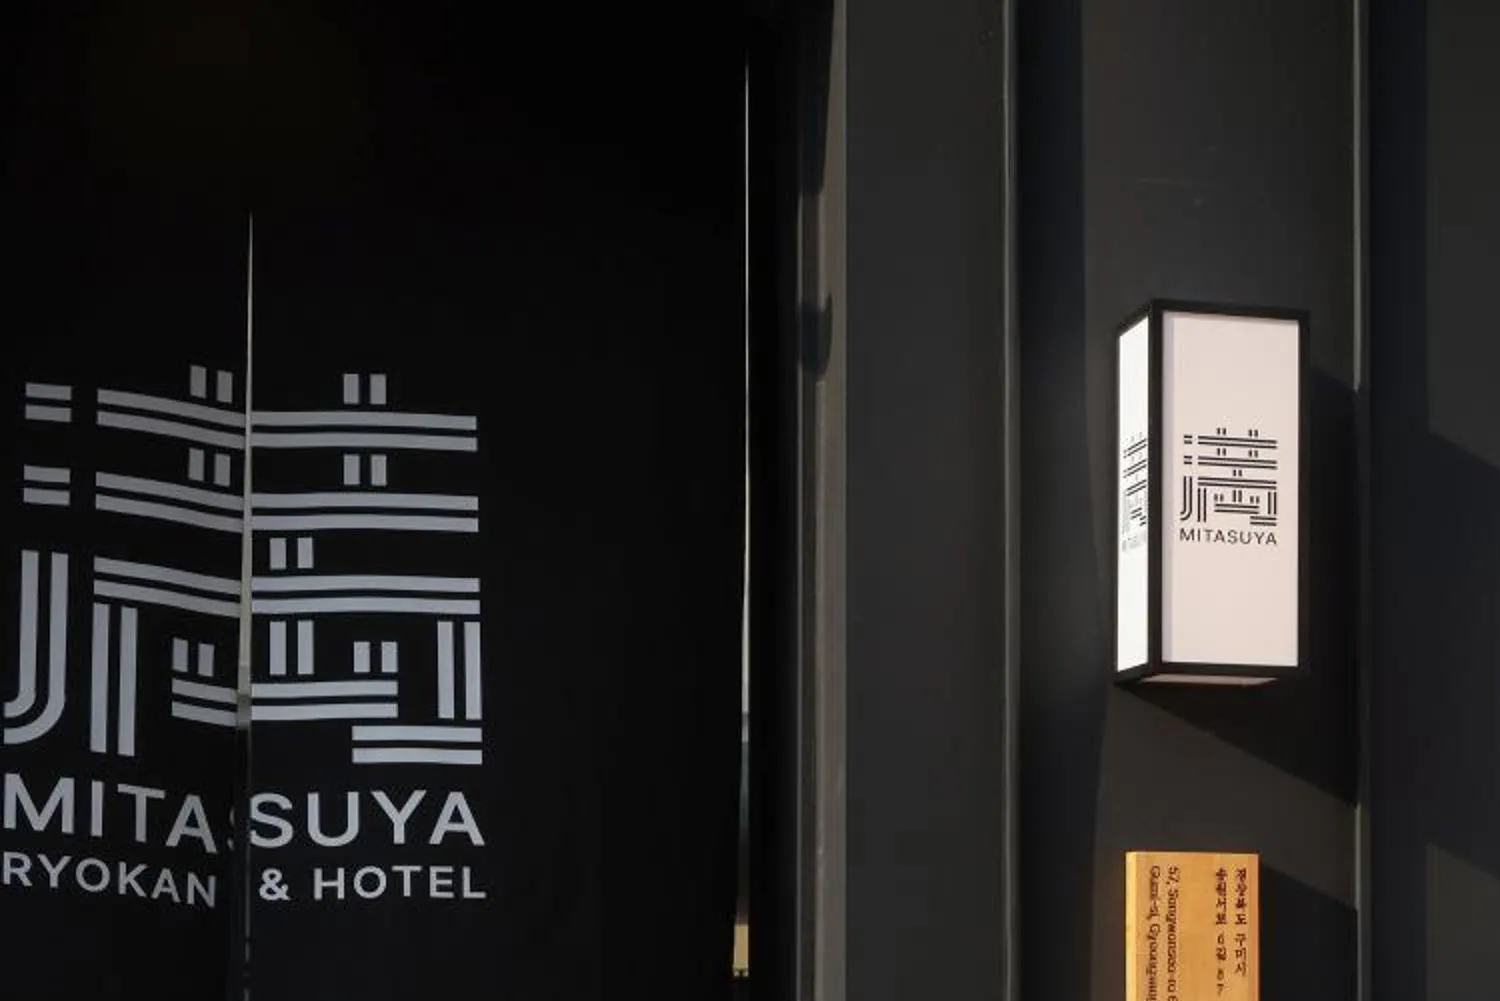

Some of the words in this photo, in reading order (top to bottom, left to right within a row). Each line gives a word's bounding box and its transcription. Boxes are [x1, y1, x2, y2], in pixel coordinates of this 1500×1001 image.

[1179, 527, 1278, 545] MITASUYA
[3, 772, 485, 853] MITASUYA
[2, 851, 217, 907] RYOKAN
[258, 868, 291, 901] &
[313, 865, 487, 901] HOTEL
